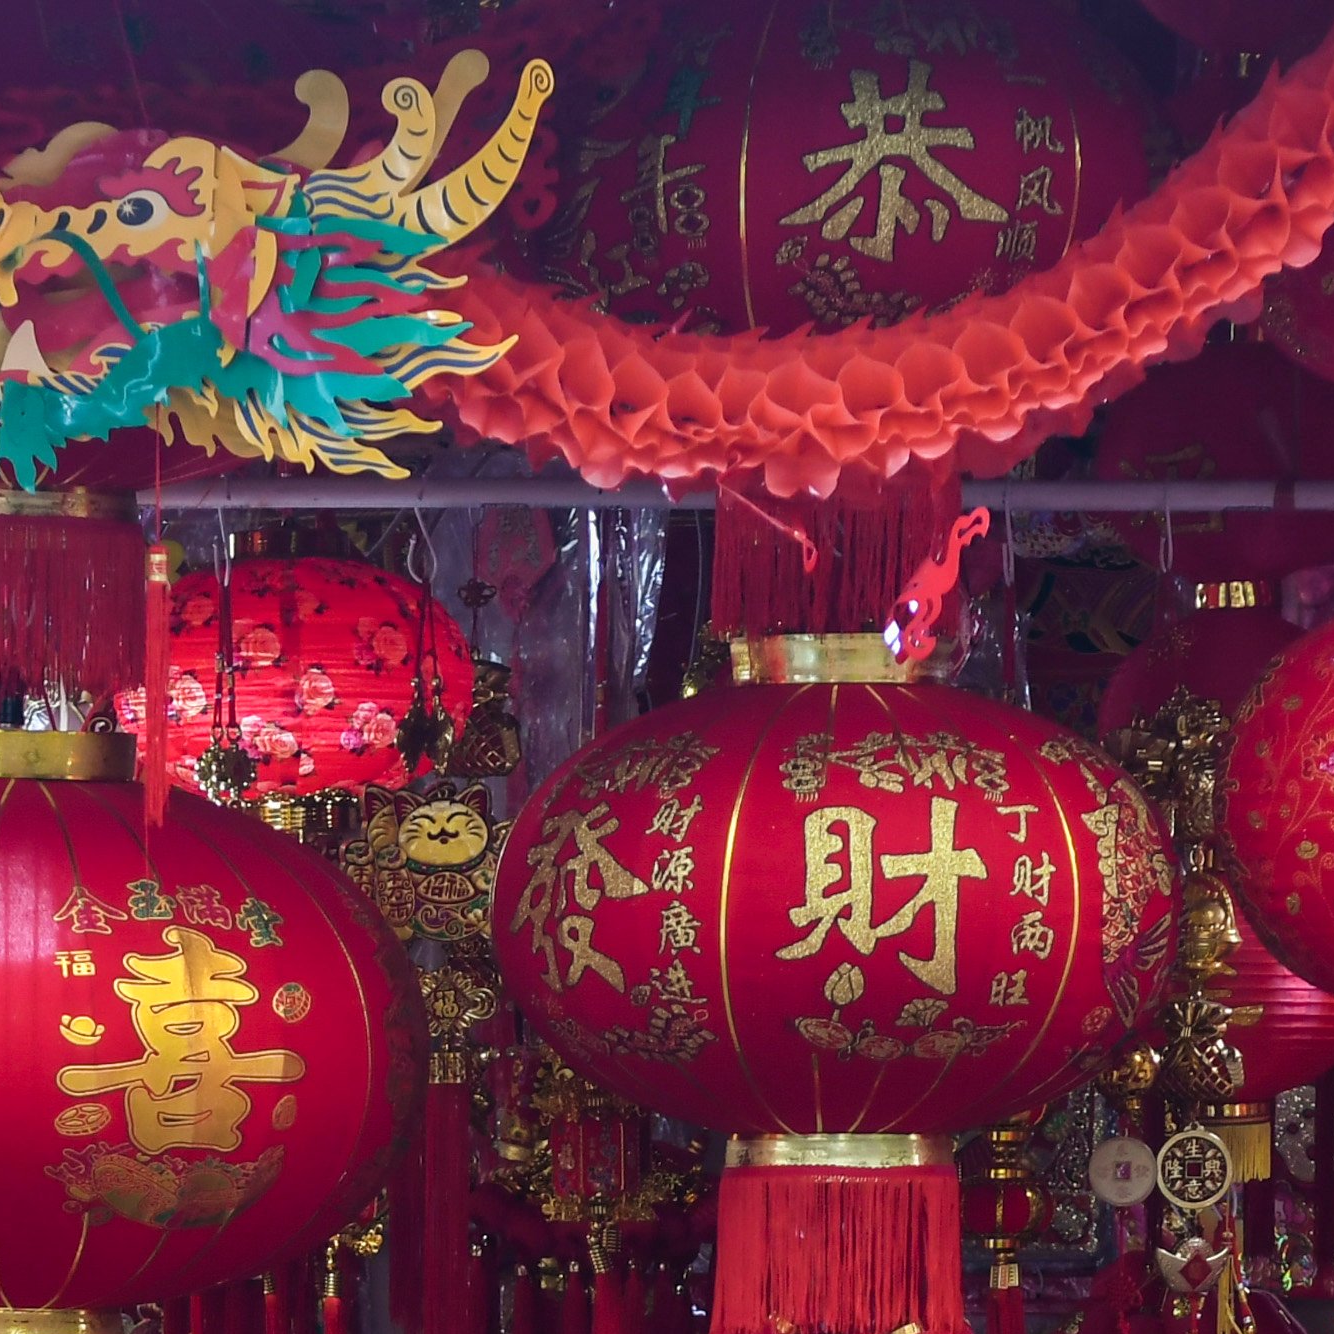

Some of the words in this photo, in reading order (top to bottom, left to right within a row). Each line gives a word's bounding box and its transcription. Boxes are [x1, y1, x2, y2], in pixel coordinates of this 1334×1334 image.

[779, 60, 1009, 263] 恭
[776, 795, 987, 997] 財
[56, 925, 306, 1153] 喜
